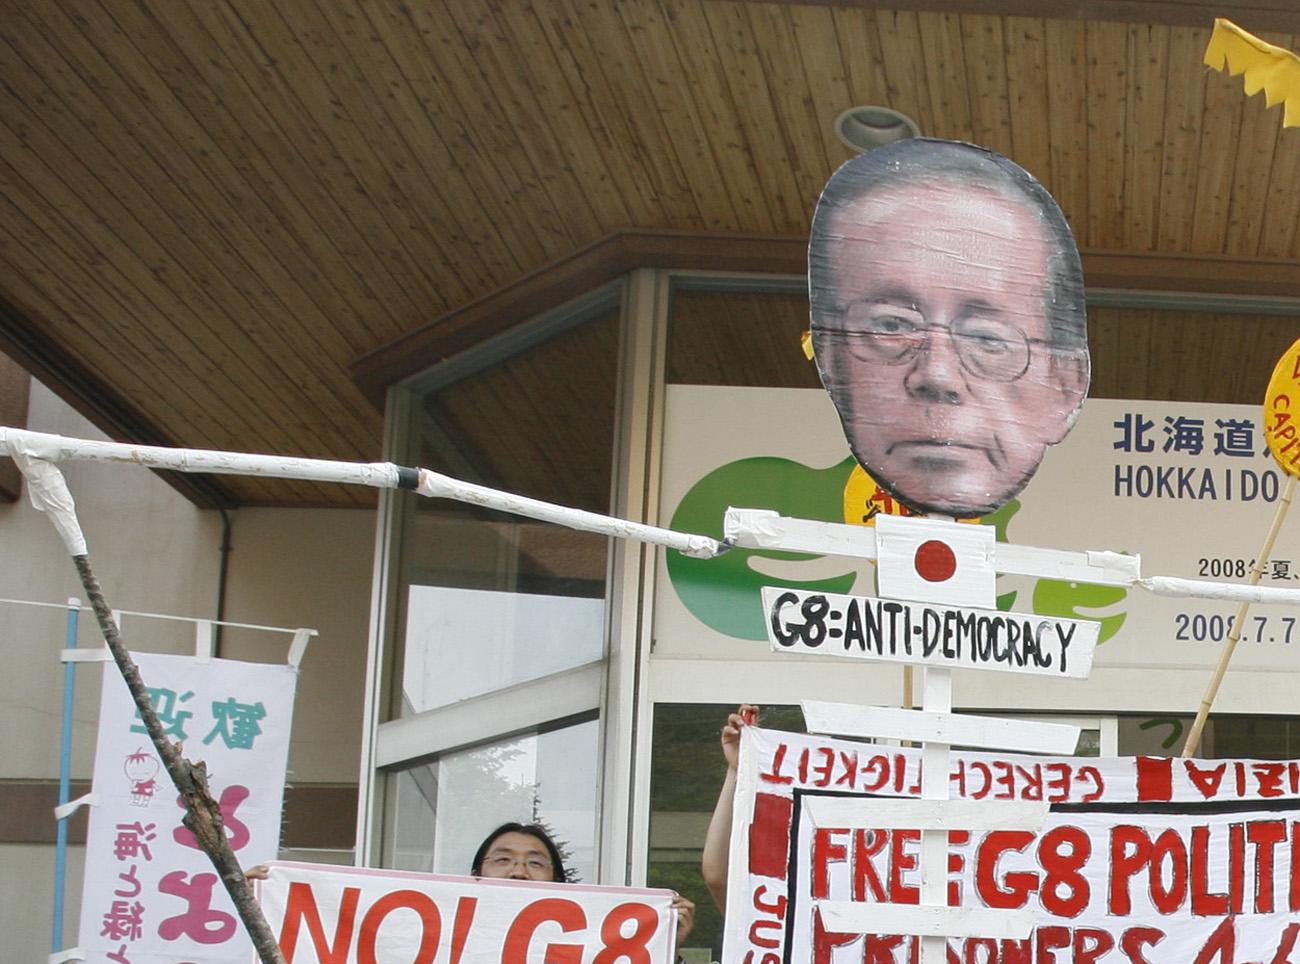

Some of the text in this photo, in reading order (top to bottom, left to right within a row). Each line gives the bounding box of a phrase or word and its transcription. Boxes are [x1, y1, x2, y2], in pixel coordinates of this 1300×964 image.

[1114, 465, 1279, 502] HOKKAIDO
[771, 591, 1076, 672] G8=ANTI-DEMOCRACY
[975, 825, 1092, 918] G8
